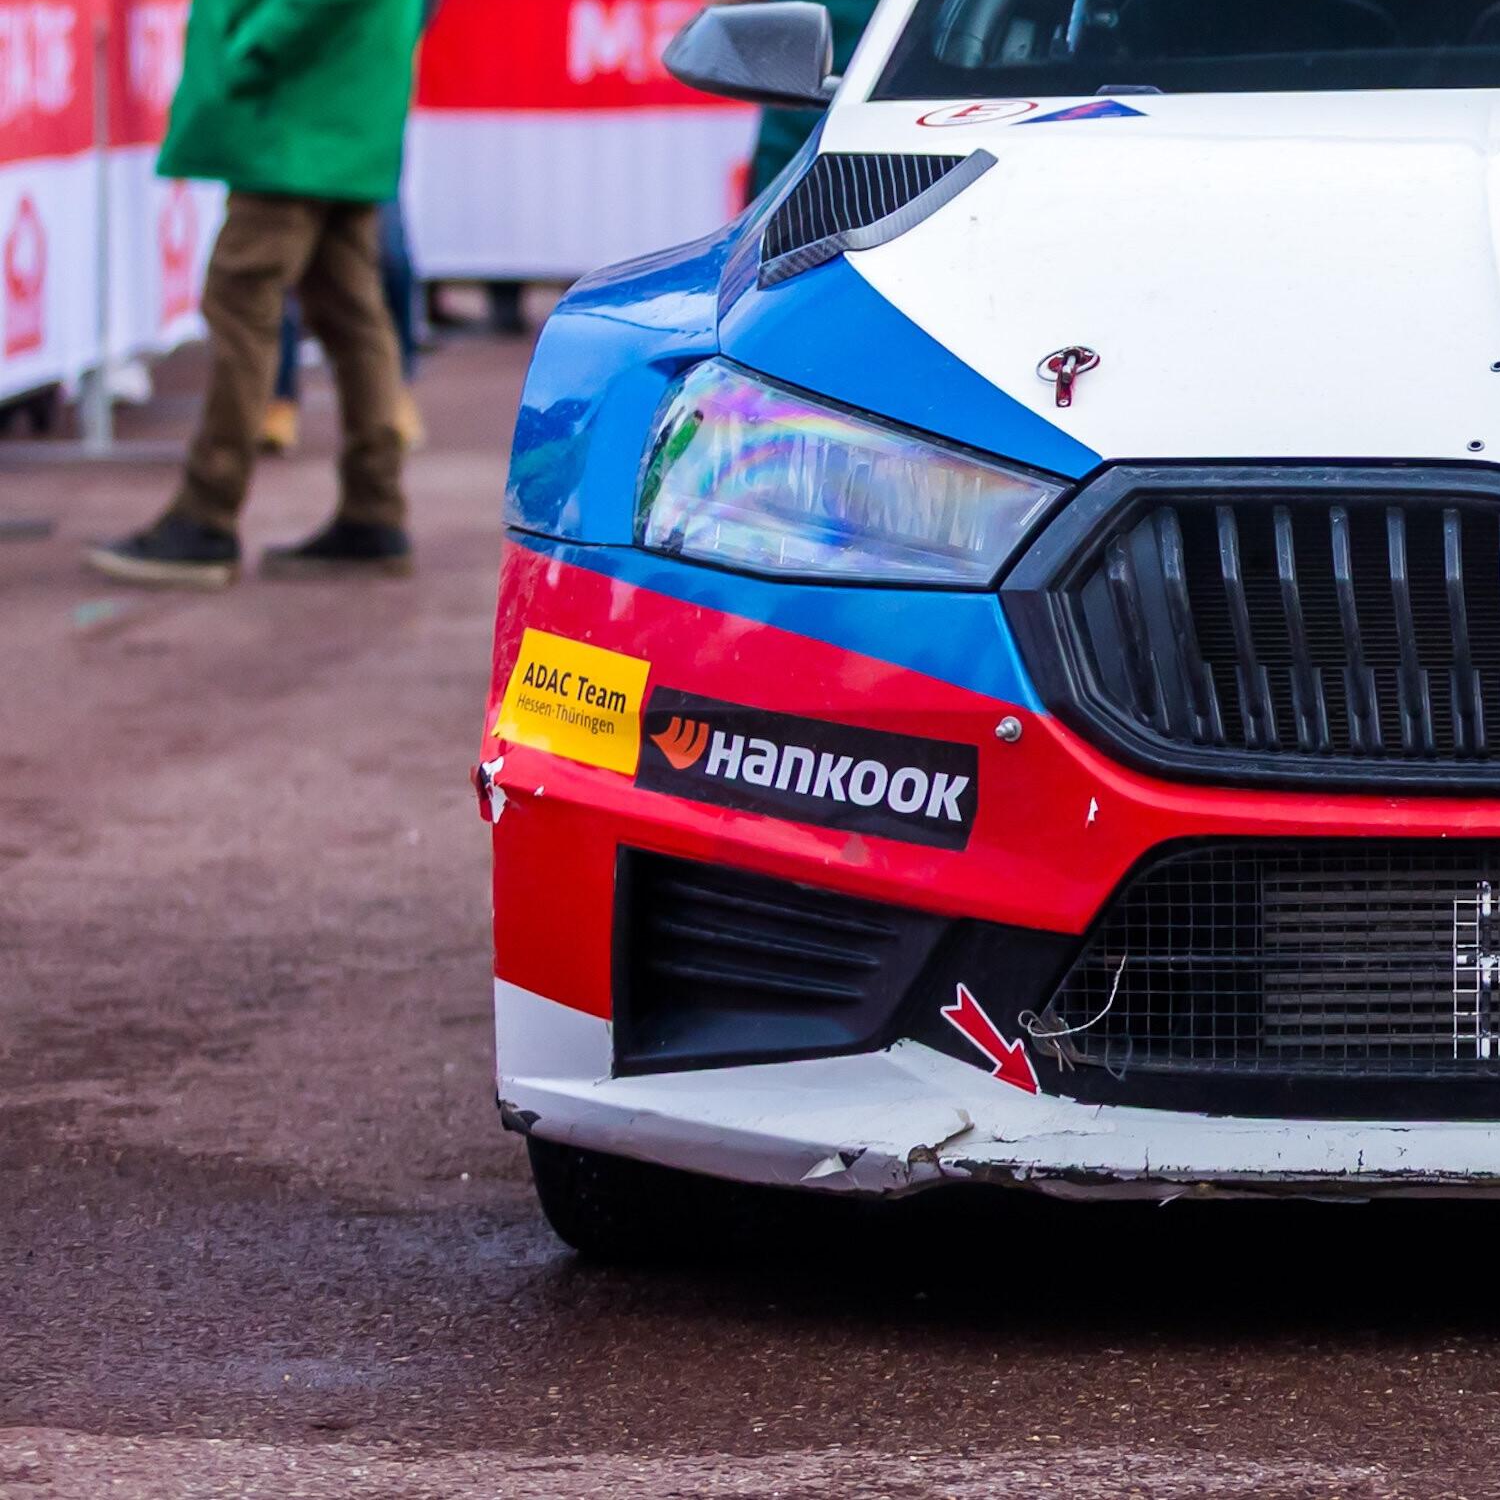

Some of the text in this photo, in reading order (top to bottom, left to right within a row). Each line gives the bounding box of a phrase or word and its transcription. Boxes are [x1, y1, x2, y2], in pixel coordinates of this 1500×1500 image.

[522, 661, 627, 715] ADAC Team
[516, 692, 615, 735] Hessen-Thüringen
